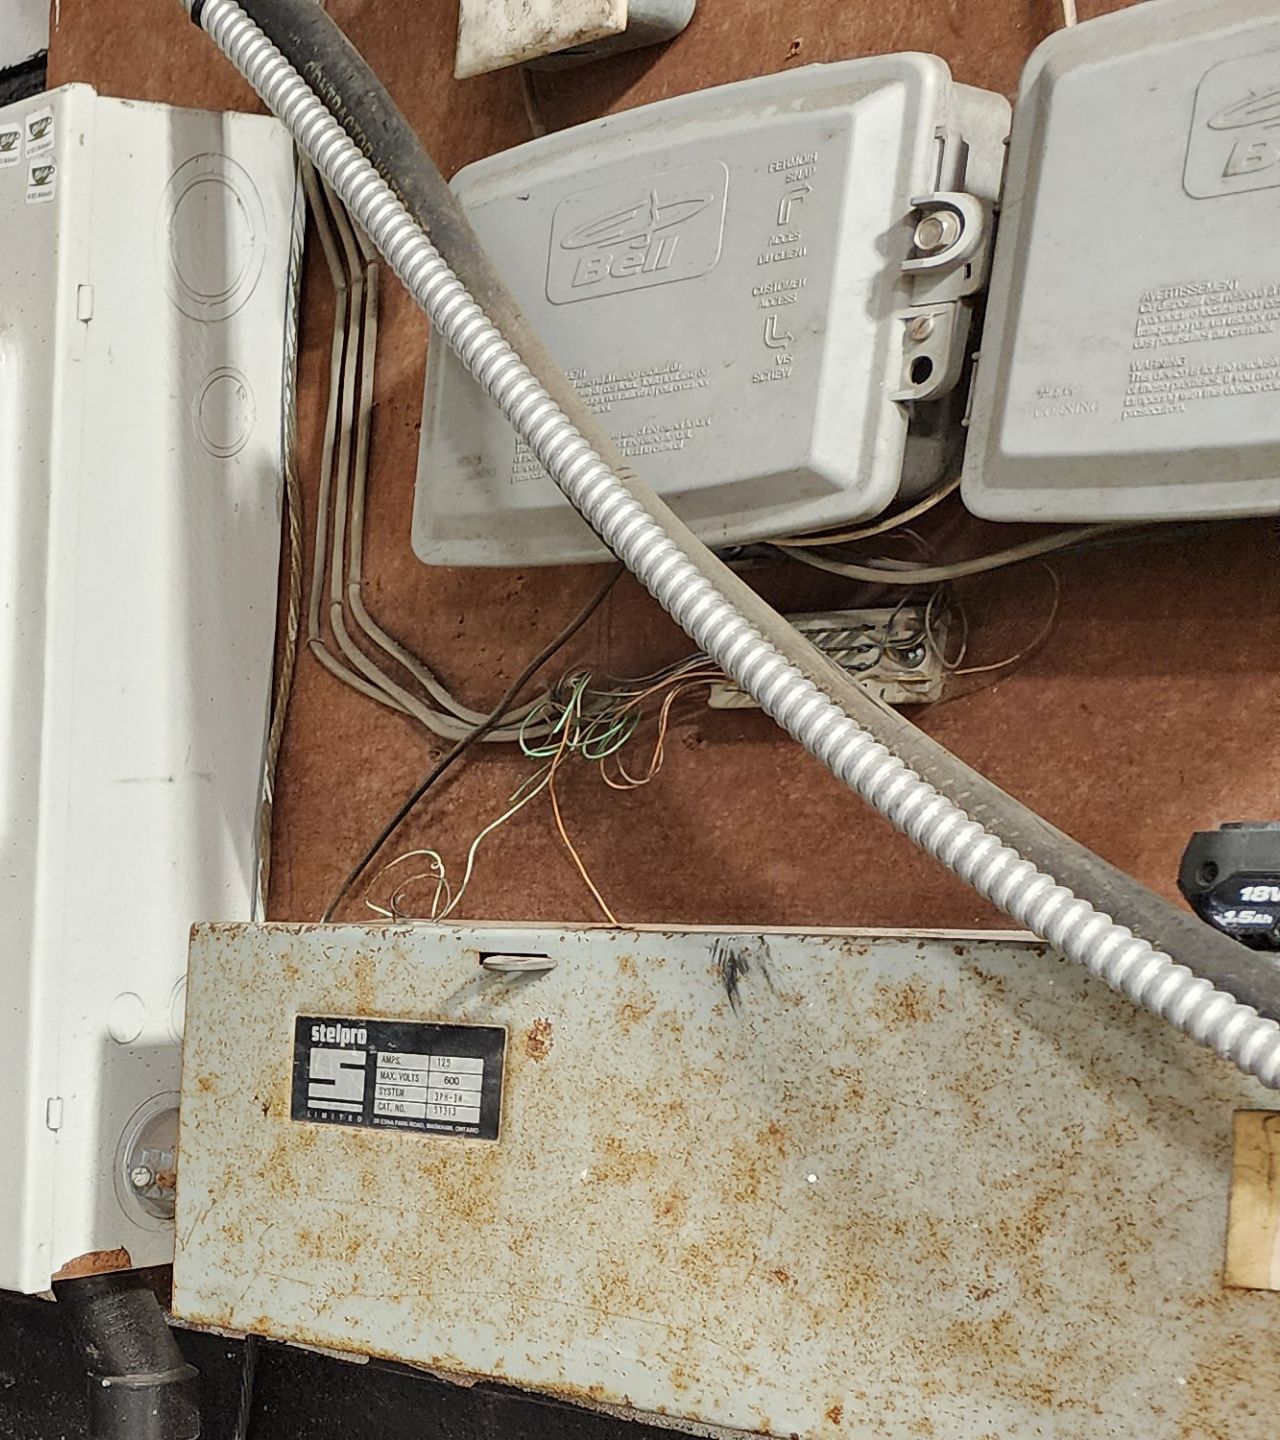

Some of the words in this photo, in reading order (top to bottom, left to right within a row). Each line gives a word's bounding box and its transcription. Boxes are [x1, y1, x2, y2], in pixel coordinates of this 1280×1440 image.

[785, 167, 817, 184] SNAP
[572, 236, 679, 288] Bell
[752, 277, 807, 297] CUSTOMER
[311, 1023, 368, 1047] stelpro
[399, 1072, 420, 1083] VOLTS
[443, 1076, 460, 1085] 600
[379, 1086, 405, 1096] SYSTEM
[307, 1111, 363, 1123] LIMITED
